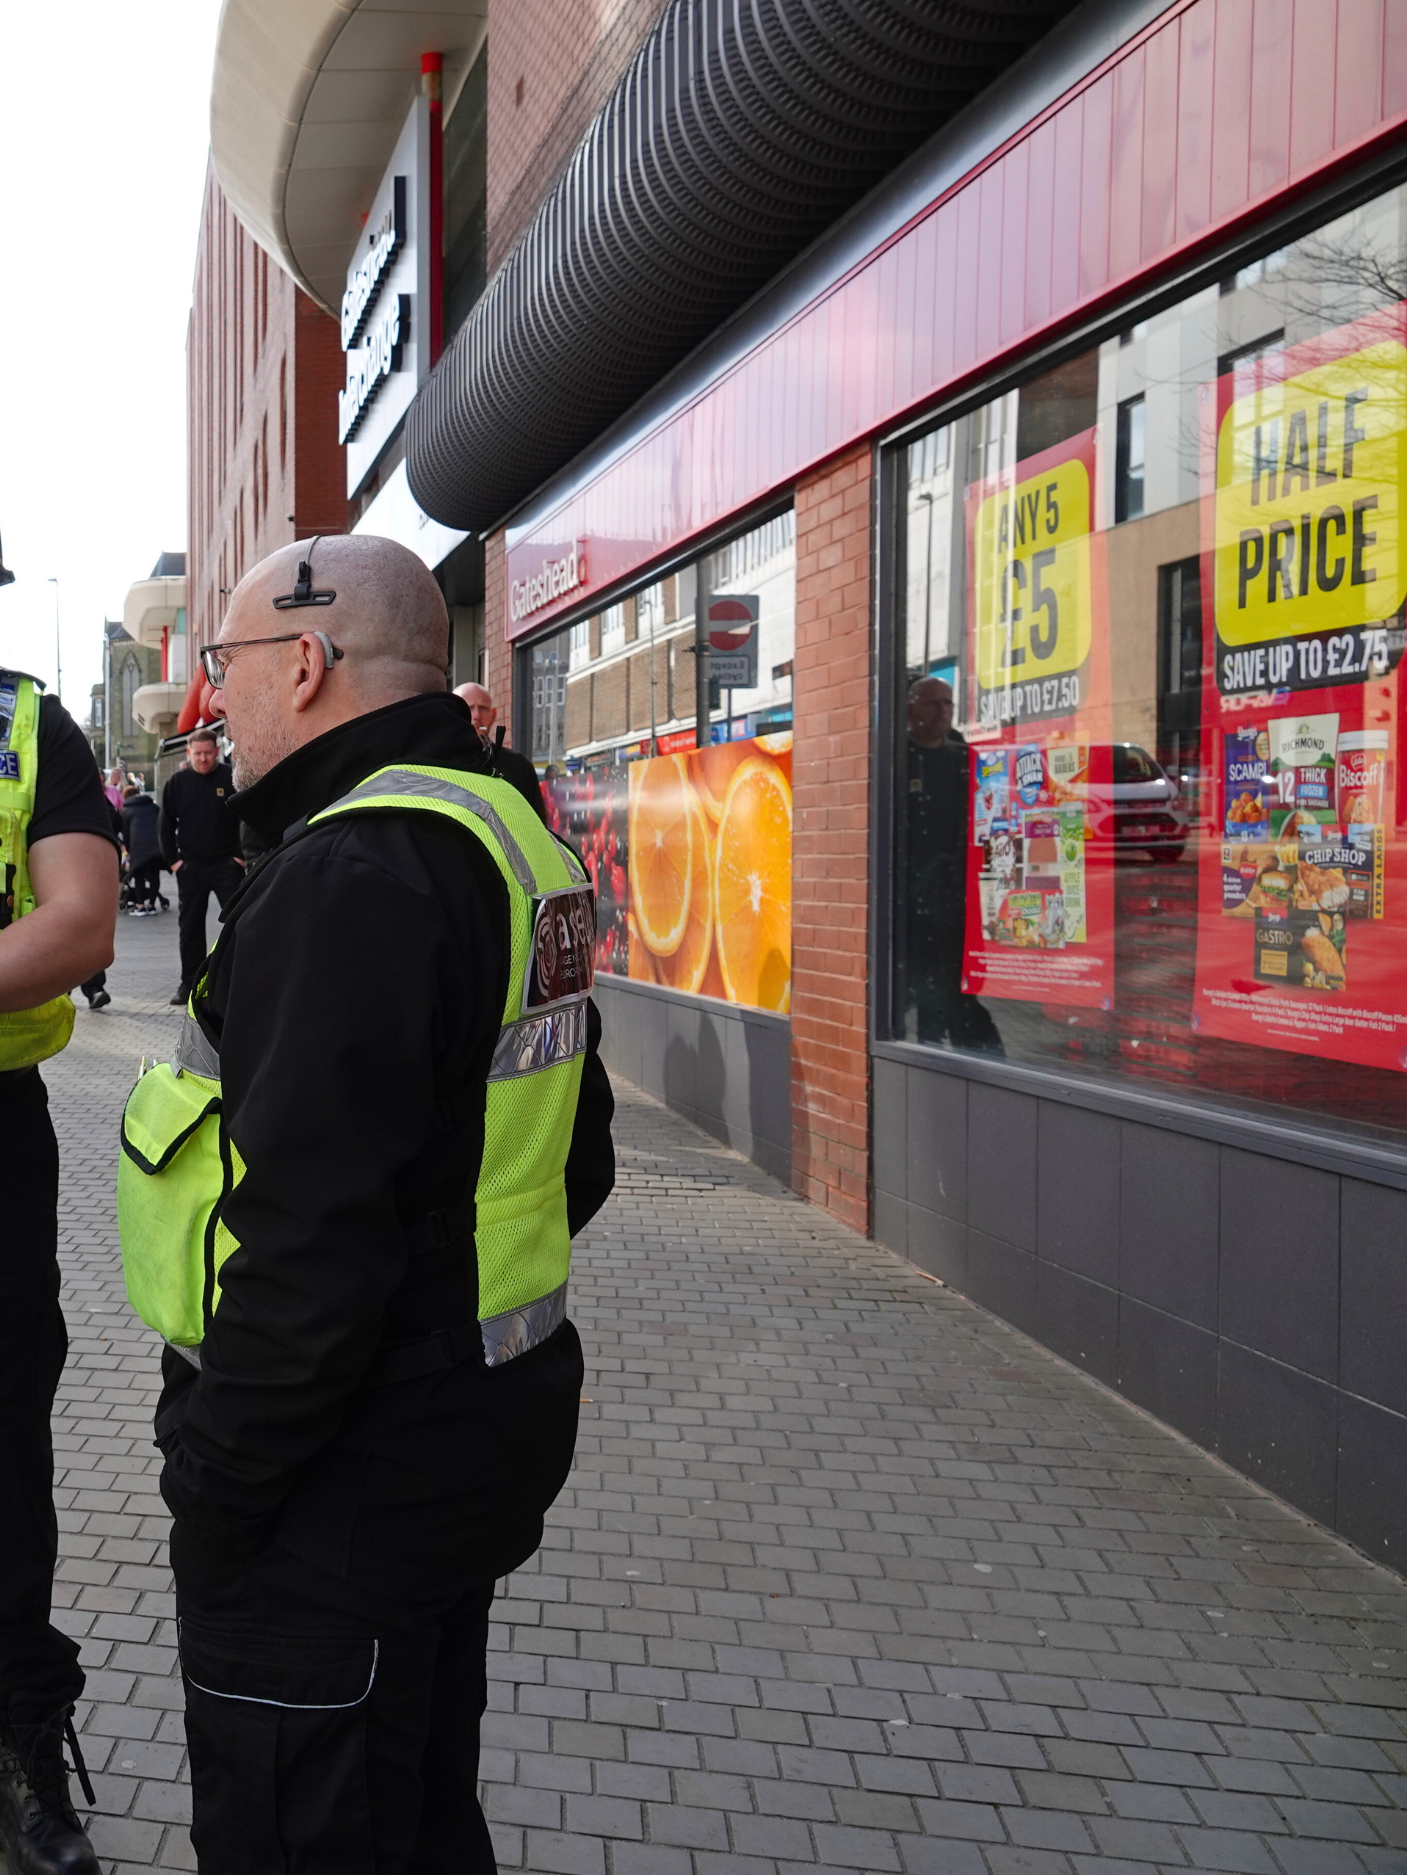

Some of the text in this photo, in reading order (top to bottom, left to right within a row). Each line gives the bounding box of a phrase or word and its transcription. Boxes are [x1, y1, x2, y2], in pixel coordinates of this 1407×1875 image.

[1251, 386, 1369, 507] HALF
[998, 482, 1060, 554] ANY 5
[1238, 494, 1378, 609] PRICE
[510, 540, 578, 623] Gateshead
[1000, 546, 1059, 668] £5
[1224, 628, 1388, 691] SAVE UP TO £2.75
[980, 675, 1079, 724] SAVE UP TO £7.50
[1281, 738, 1326, 754] RICHMOND
[1276, 771, 1294, 803] 12
[1300, 768, 1327, 783] THICK
[1340, 763, 1378, 787] Biscoff
[1305, 848, 1366, 866] CHIP SHOP
[1256, 929, 1293, 945] GASTRO
